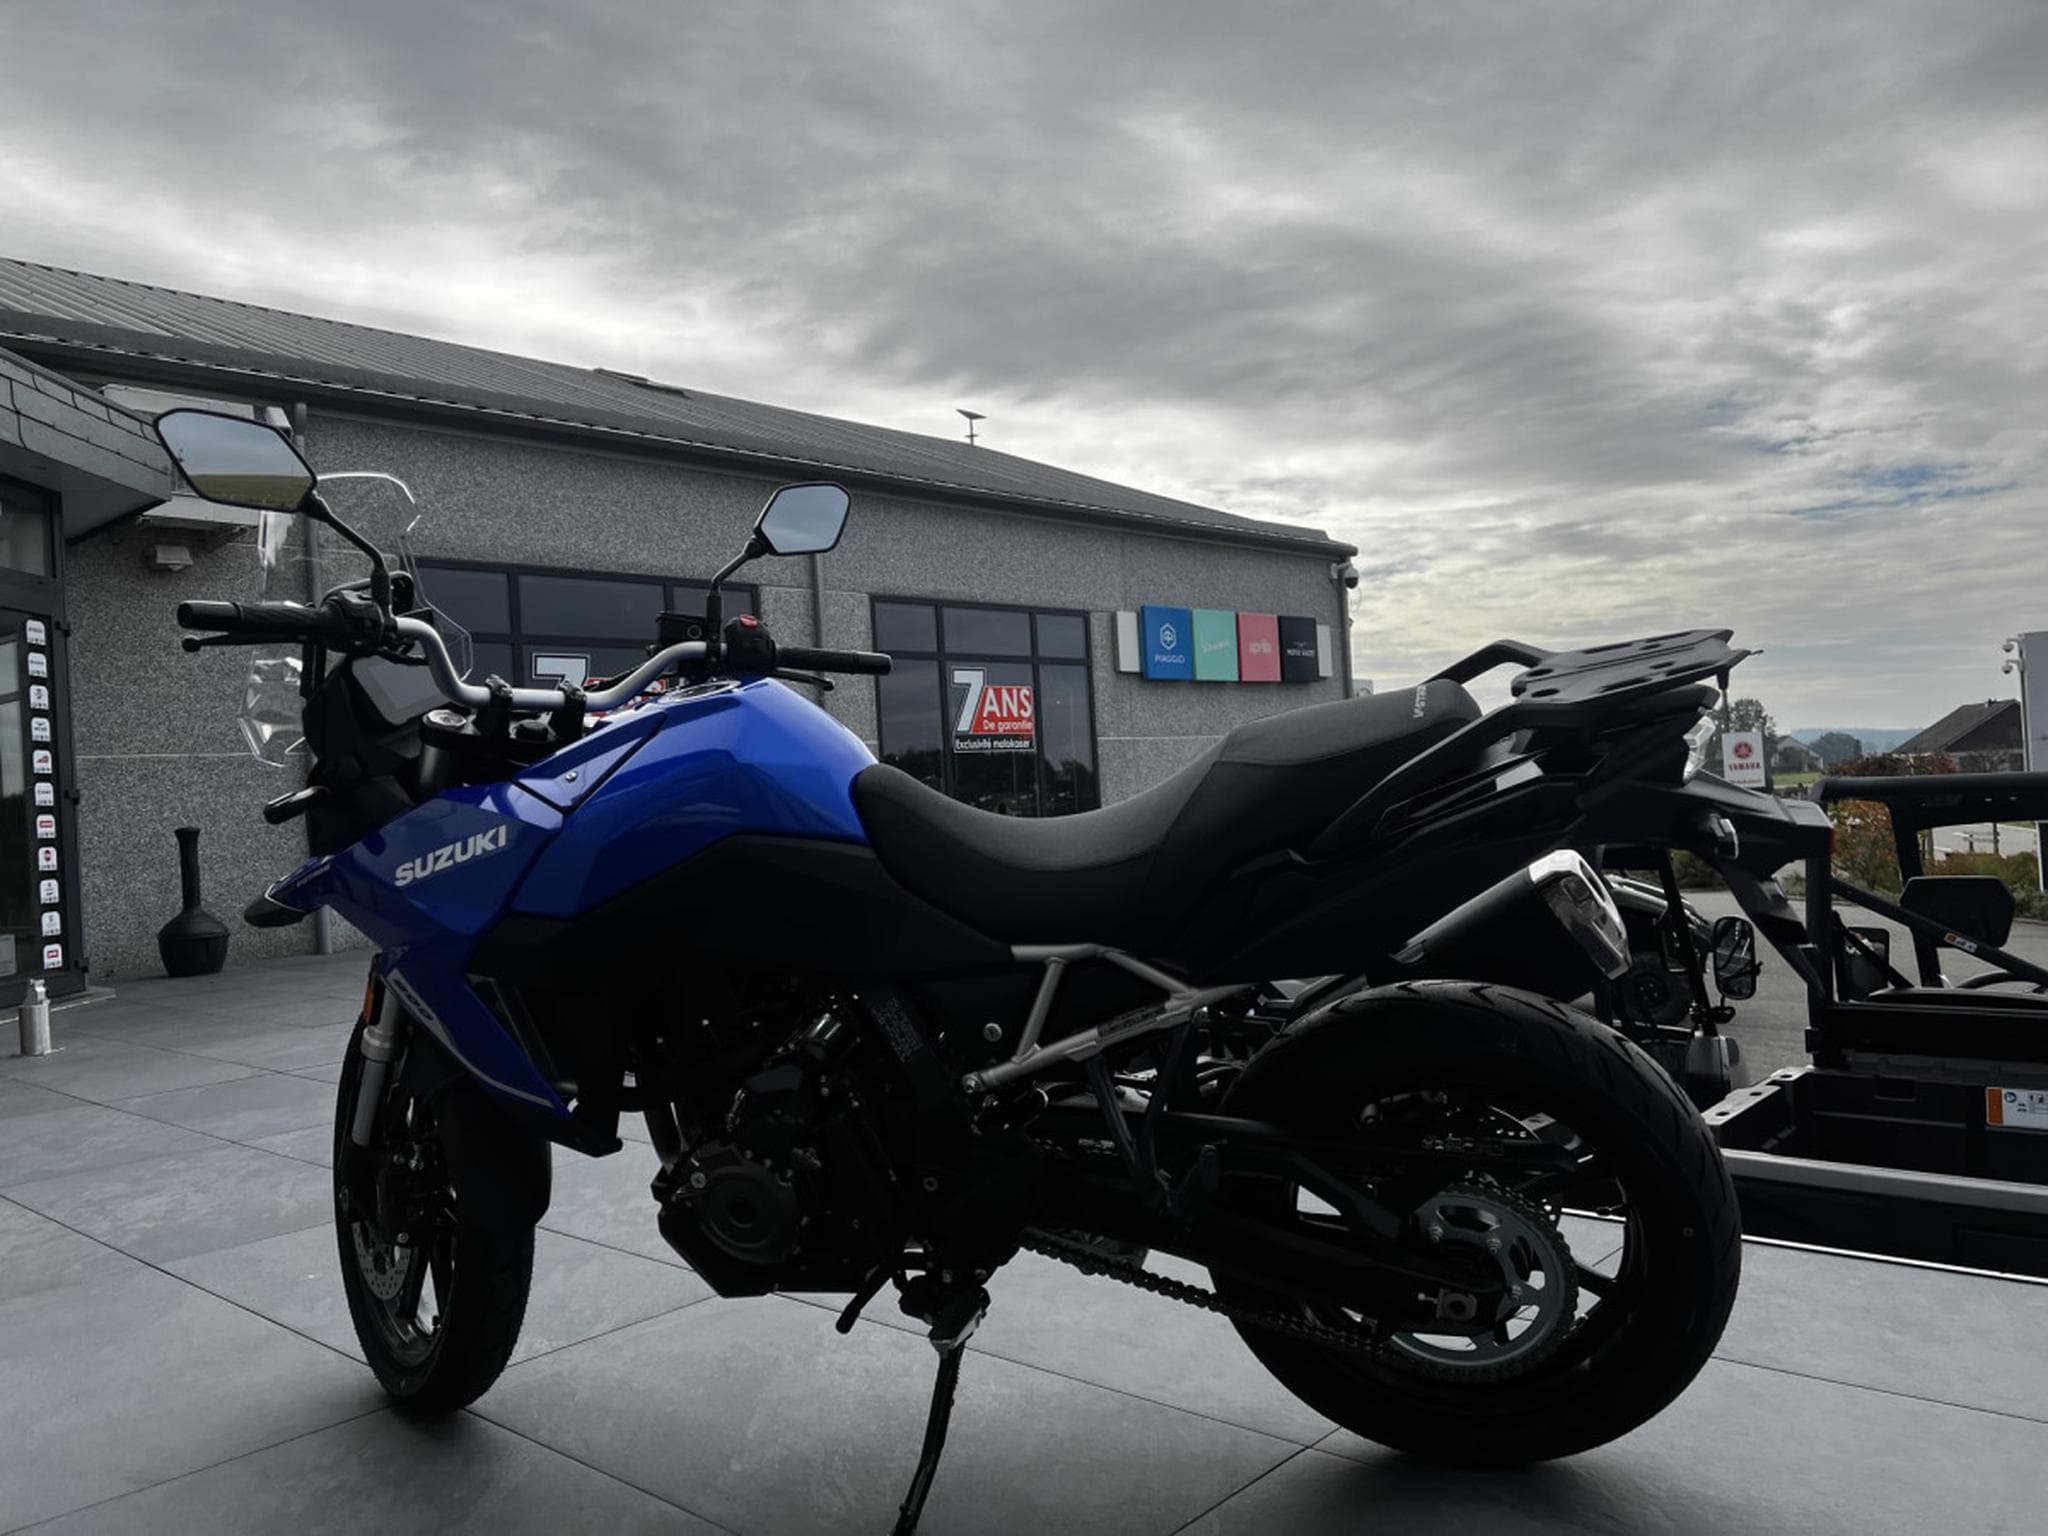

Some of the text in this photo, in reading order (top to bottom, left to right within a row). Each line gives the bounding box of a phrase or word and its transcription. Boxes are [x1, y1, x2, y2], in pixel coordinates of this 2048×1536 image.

[1154, 653, 1185, 664] PIAGGIO
[953, 670, 1032, 732] 7 ANS
[983, 719, 1033, 732] De garantie
[1728, 762, 1761, 771] YAMAHA
[394, 824, 507, 887] SUZUKI
